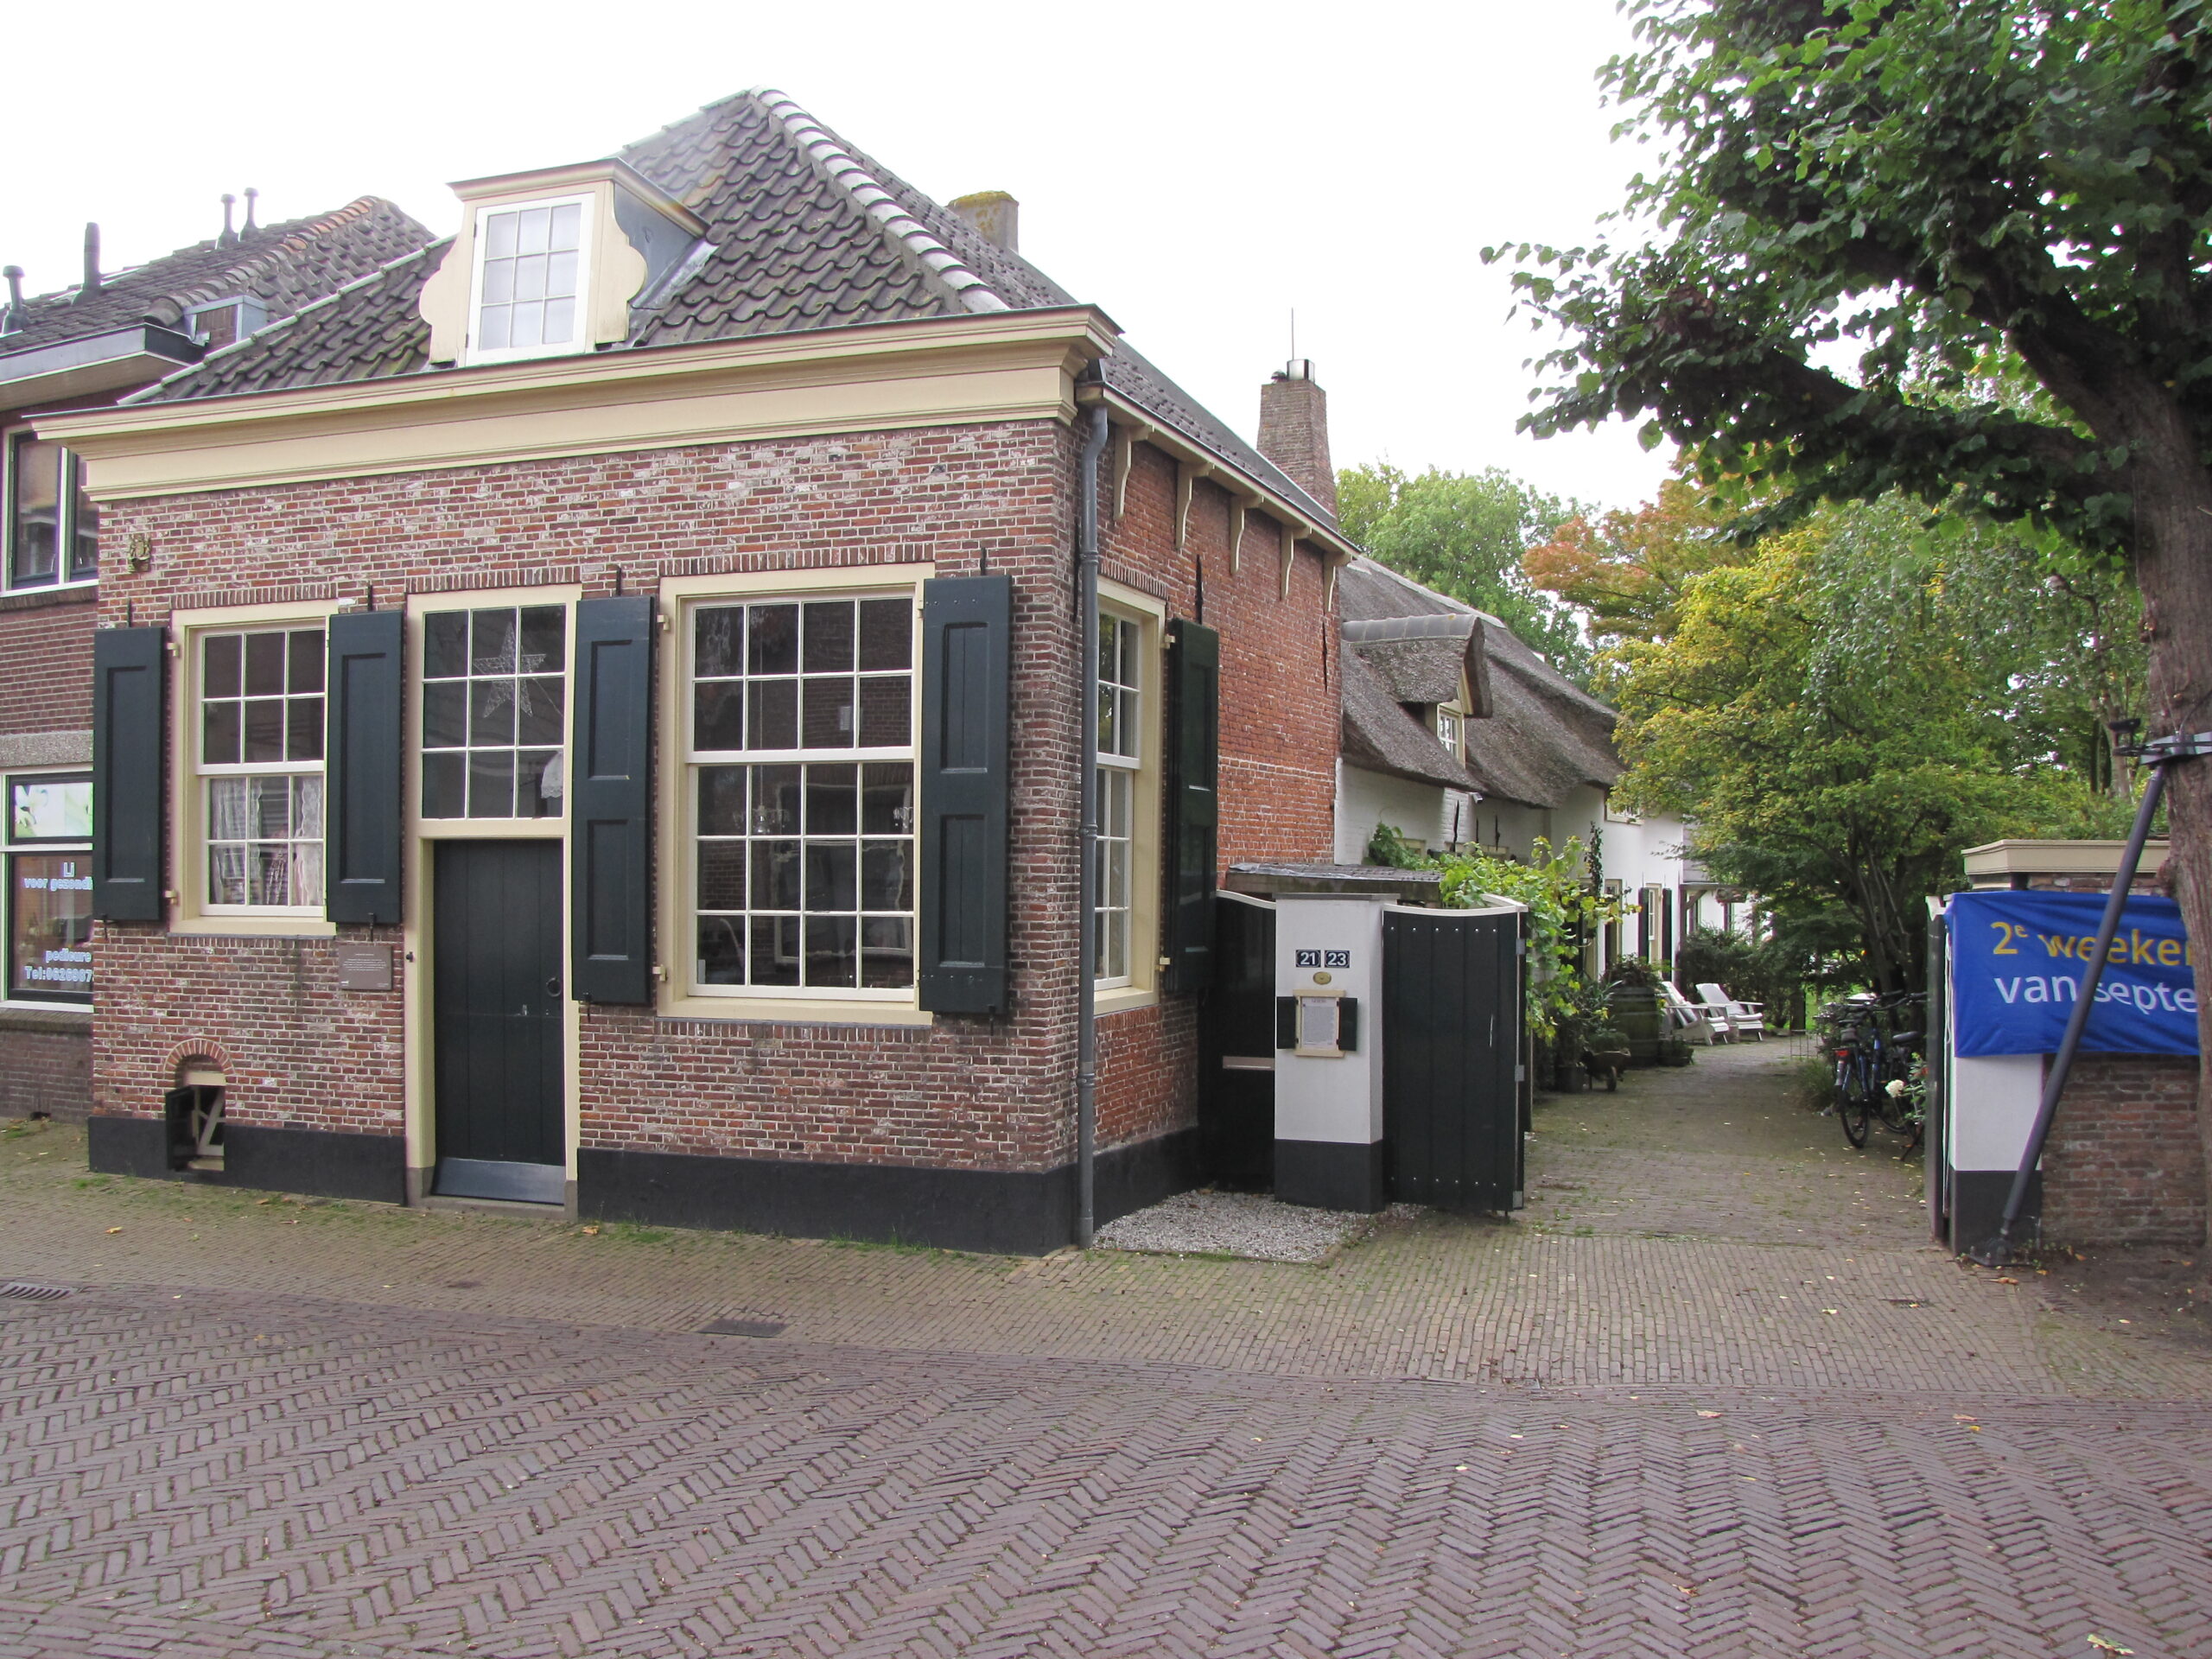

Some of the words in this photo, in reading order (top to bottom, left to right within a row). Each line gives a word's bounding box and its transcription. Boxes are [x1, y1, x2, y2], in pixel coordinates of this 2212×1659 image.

[23, 878, 48, 889] voor
[45, 948, 92, 963] pedicure
[1300, 952, 1316, 965] 21
[1327, 952, 1347, 966] 23
[1993, 976, 2077, 1004] van
